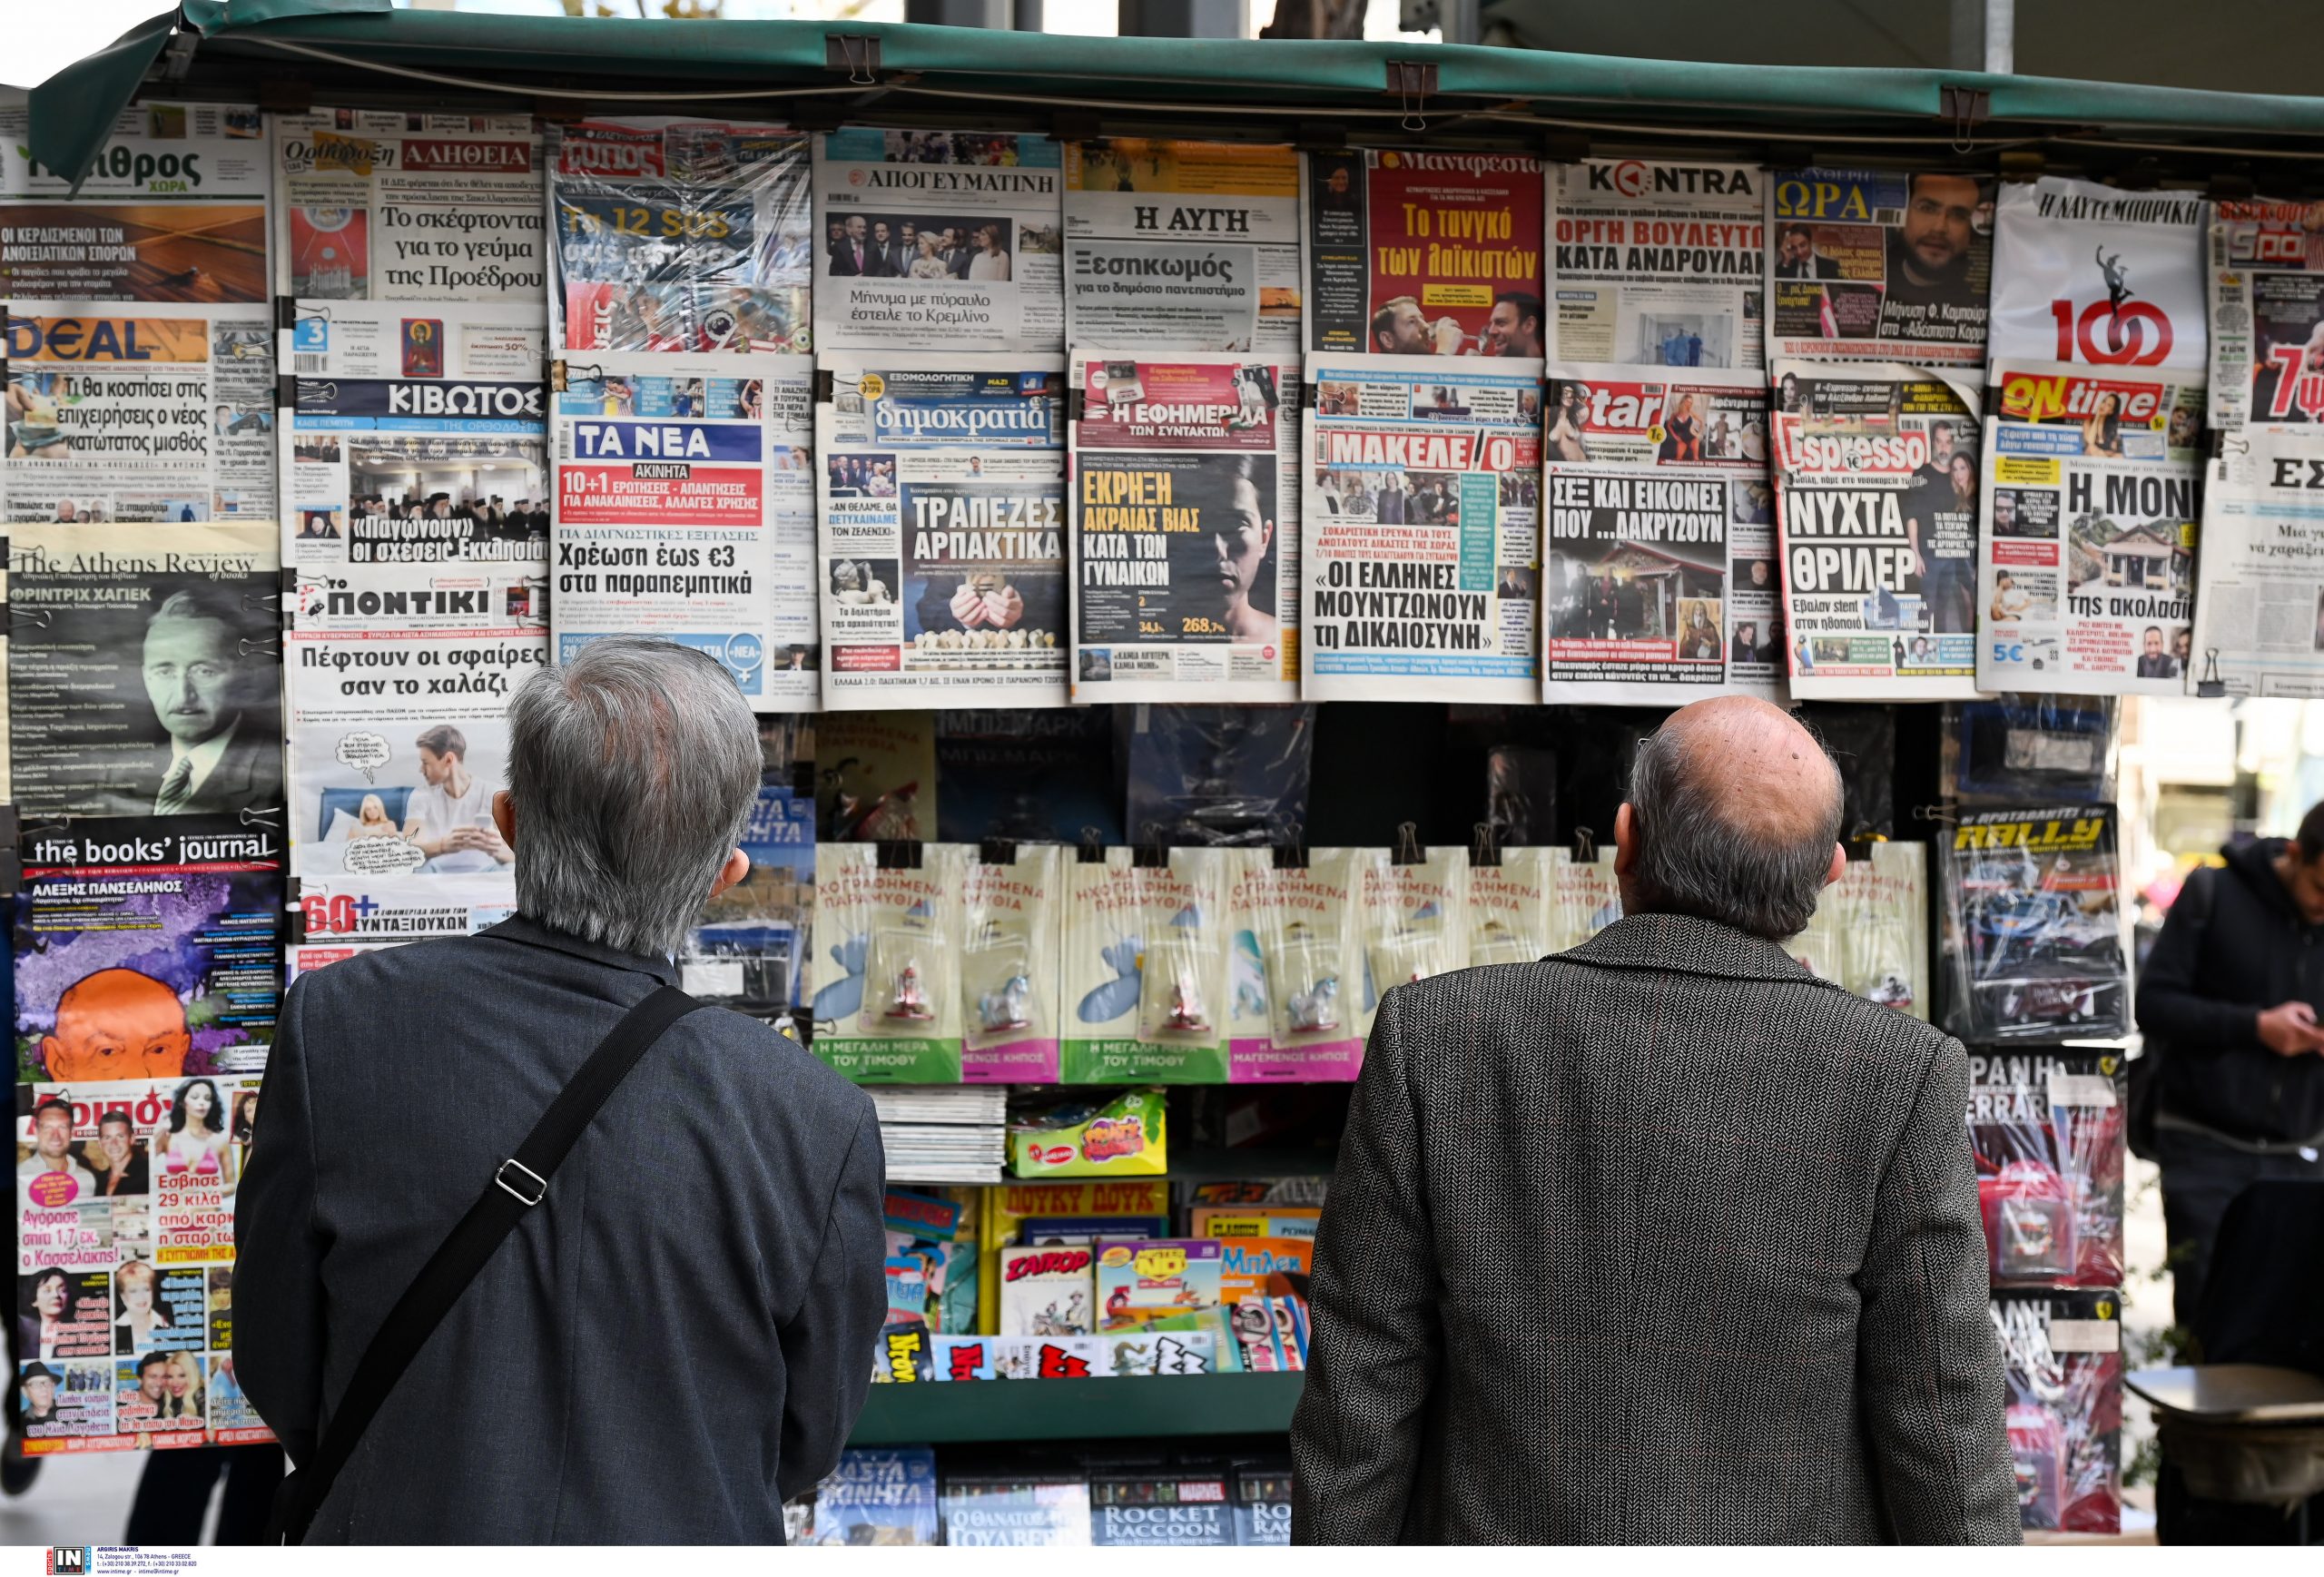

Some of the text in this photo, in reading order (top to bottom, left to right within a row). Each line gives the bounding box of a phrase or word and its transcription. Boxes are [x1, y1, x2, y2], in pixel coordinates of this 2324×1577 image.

[405, 145, 527, 164] ΑΛΗΘΕΙΑ
[150, 181, 187, 192] ΧΩΡΑ
[868, 171, 1054, 192] ΑΠΟΓΕΥΜΑΤΙΝΗ
[1777, 182, 1870, 220] ΩΡΑ
[2039, 194, 2055, 217] Η
[1135, 206, 1249, 232] Η ΑΥΓΗ
[1403, 203, 1512, 243] Το τανγκό
[396, 237, 533, 261] για το γεύμα
[1378, 243, 1537, 280] των λαϊκιστών
[385, 266, 542, 291] της Προέδρου
[1075, 250, 1233, 282] Ξεσηκωμός
[851, 291, 990, 308] Μήνυμα με πύραυλο
[1075, 282, 1246, 298] για το δημόσιο πανεπιστήμιο
[852, 307, 990, 324] έστειλε το Κρεμλίνο
[2052, 300, 2173, 366] 100
[64, 376, 206, 402] Τι θα κοστίσει στις
[389, 385, 543, 416] ΚΙΒΩΤΟΣ
[56, 402, 206, 429] επιχειρήσεις ο νέος
[876, 401, 1046, 436] δημοκρατία
[66, 429, 207, 455] κατώτατος μισθός
[578, 425, 624, 456] ΤΑ
[636, 426, 710, 458] ΝΕΑ
[1129, 425, 1229, 437] ΤΩΝ ΣΥΝΤΑΚΤΩΝ
[1785, 426, 1925, 472] Espresso
[563, 471, 746, 496] 10+1 ΕΡΩΤΗΣΕΙΣ ΑΠΑΝΤΗΣΕΙΣ
[635, 465, 688, 478] ΑΚΙΝΗΤΑ
[1083, 471, 1172, 505] ΕΚΡΗΞΗ
[1553, 478, 1722, 511] ΣΕΞ ΚΑΙ ΕΙΚΟΝΕΣ
[564, 496, 758, 509] ΓΙΑ ΑΝΑΚΑΙΝΙΣΕΙΣ, ΑΛΛΑΓΕΣ ΧΡΗΣΗΣ
[829, 503, 897, 512] «ΑΝ ΘΕΛΑΜΕ, ΘΑ
[912, 497, 1061, 527] ΤΡΑΠΕΖΕΣ
[1789, 491, 1905, 536] ΝΥΧΤΑ
[1084, 508, 1200, 533] ΑΚΡΑΙΑΣ ΒΙΑΣ
[1323, 527, 1452, 538] ΣΟΚΑΡΙΣΤΙΚΗ ΕΡΕΥΝΑ ΓΙΑ ΤΟΥΣ
[1553, 509, 1592, 538] ΠΟΥ
[559, 542, 734, 570] Χρέωση έως €3
[913, 532, 1061, 559] ΑΡΠΑΚΤΙΚΑ
[1084, 534, 1167, 559] ΚΑΤΑ ΤΩΝ
[21, 552, 254, 573] The Athens Review
[1084, 561, 1169, 586] ΓΥΝΑΙΚΩΝ
[1792, 547, 1917, 591] ΘΡΙΛΕΡ
[209, 571, 248, 580] of books
[559, 570, 752, 597] στα παραπεμπτικά
[1316, 561, 1455, 590] «ΟΙ ΕΛΛΗΝΕΣ
[10, 588, 151, 601] ΦΡΙΝΤΡΙΧ ΧΑΓΙΕΚ
[328, 591, 488, 615] ΠΟΝΤΙΚΙ
[1315, 591, 1486, 620] ΜΟΥΝΤΖΩΝΟΥΝ
[1793, 598, 1858, 613] Έβαλαν stent
[1314, 621, 1492, 650] τη ΔΙΚΑΙΟΣΥΝΗ»
[1795, 616, 1862, 631] στον ηθοποιό
[302, 644, 544, 672] Πέφτουν οι σφαίρες
[341, 673, 507, 697] σαν το χαλάζι
[1955, 818, 2104, 850] RALLY
[35, 833, 268, 864] the books’ journal
[34, 881, 182, 897] ΑΛΕΞΗΣ ΠΑΝΣΕΛΗΝΟΣ
[352, 916, 468, 932] ΣΥΝΤΑΞΙΟΥΧΩΝ
[820, 1041, 930, 1052] Η ΜΕΓΑΛΗ ΜΕΡΑ
[832, 1054, 917, 1066] ΤΟΥ ΤΙΜΟΘΥ
[160, 1193, 220, 1207] 29 κιλά
[24, 1247, 118, 1266] ο Κασσελάκης!
[1222, 1247, 1301, 1275] Μπλεκ
[1180, 1483, 1223, 1501] MARVEL
[1105, 1506, 1220, 1523] ROCKET
[1106, 1523, 1221, 1538] RACCOON
